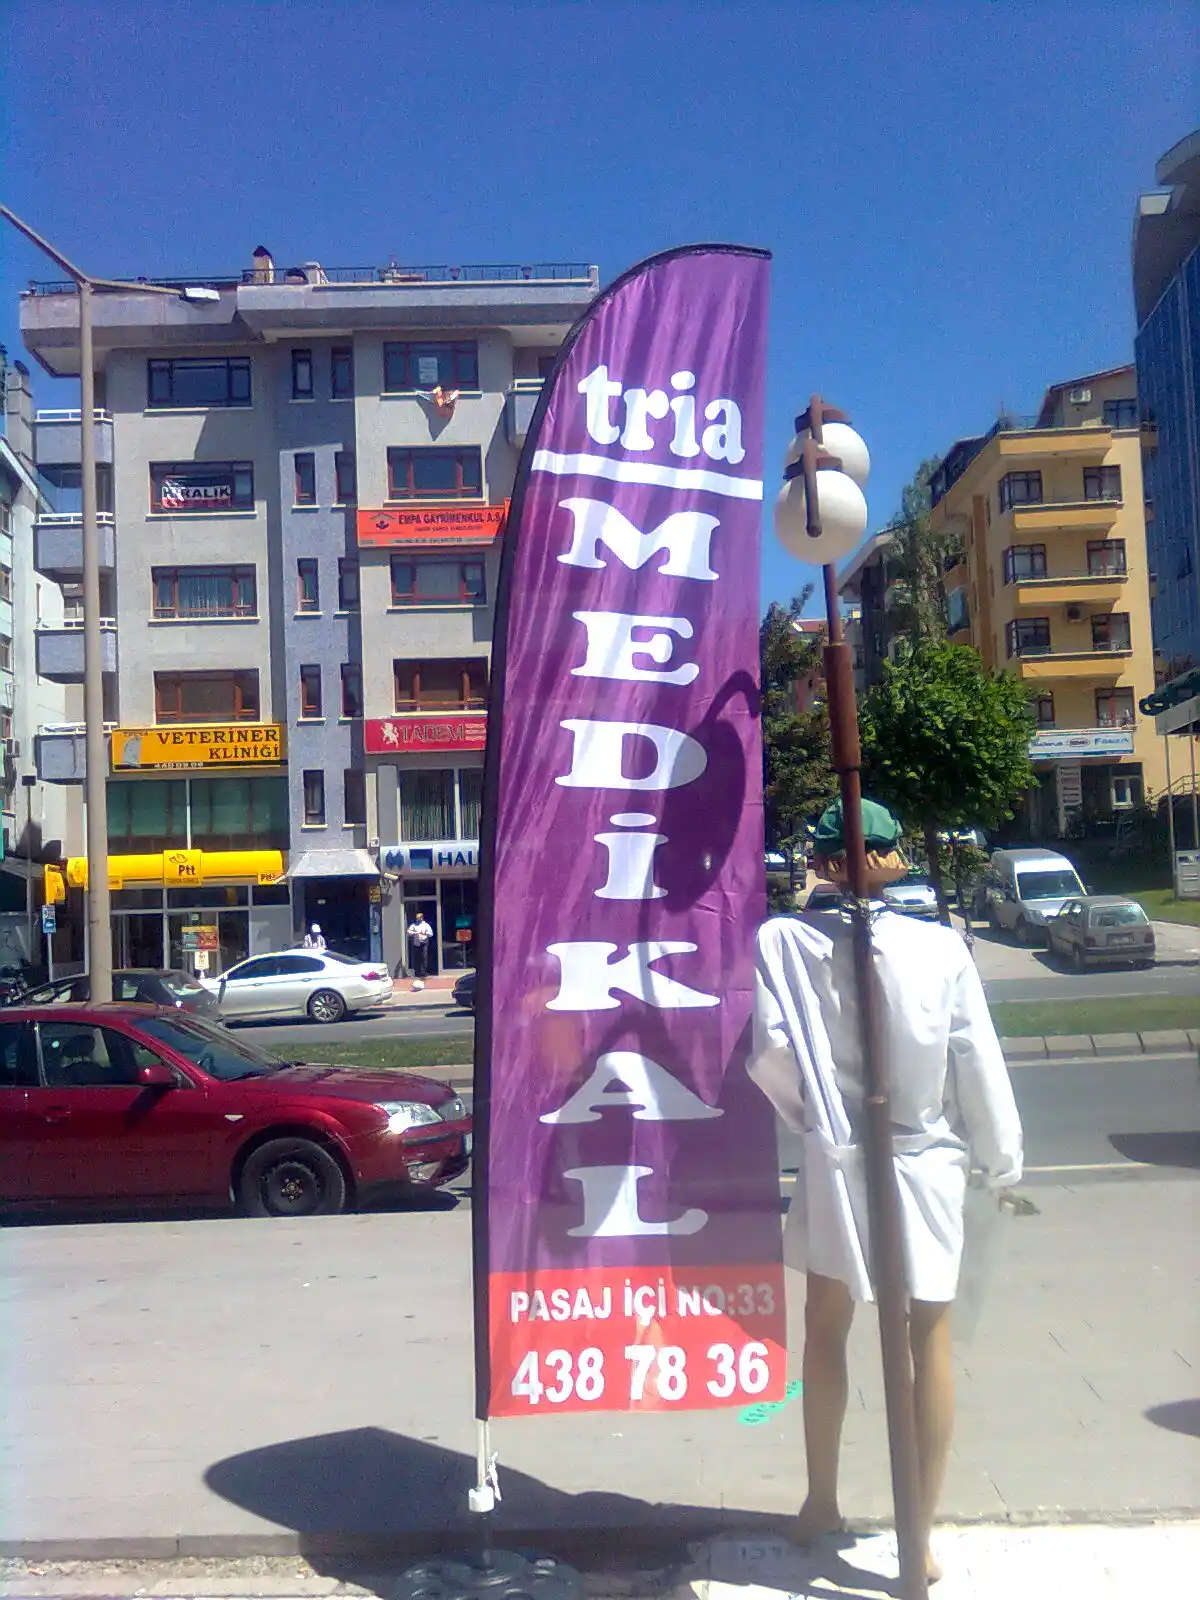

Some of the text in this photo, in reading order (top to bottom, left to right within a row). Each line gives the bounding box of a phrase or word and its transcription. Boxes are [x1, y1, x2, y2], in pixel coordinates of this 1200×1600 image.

[578, 365, 745, 464] tria
[157, 728, 279, 745] VETERİNER
[208, 744, 280, 760] KLİNİĞİ
[178, 864, 196, 876] Ptt
[511, 1277, 776, 1327] PASAJ İÇİ NO:33
[510, 1342, 770, 1405] 438 78 36
